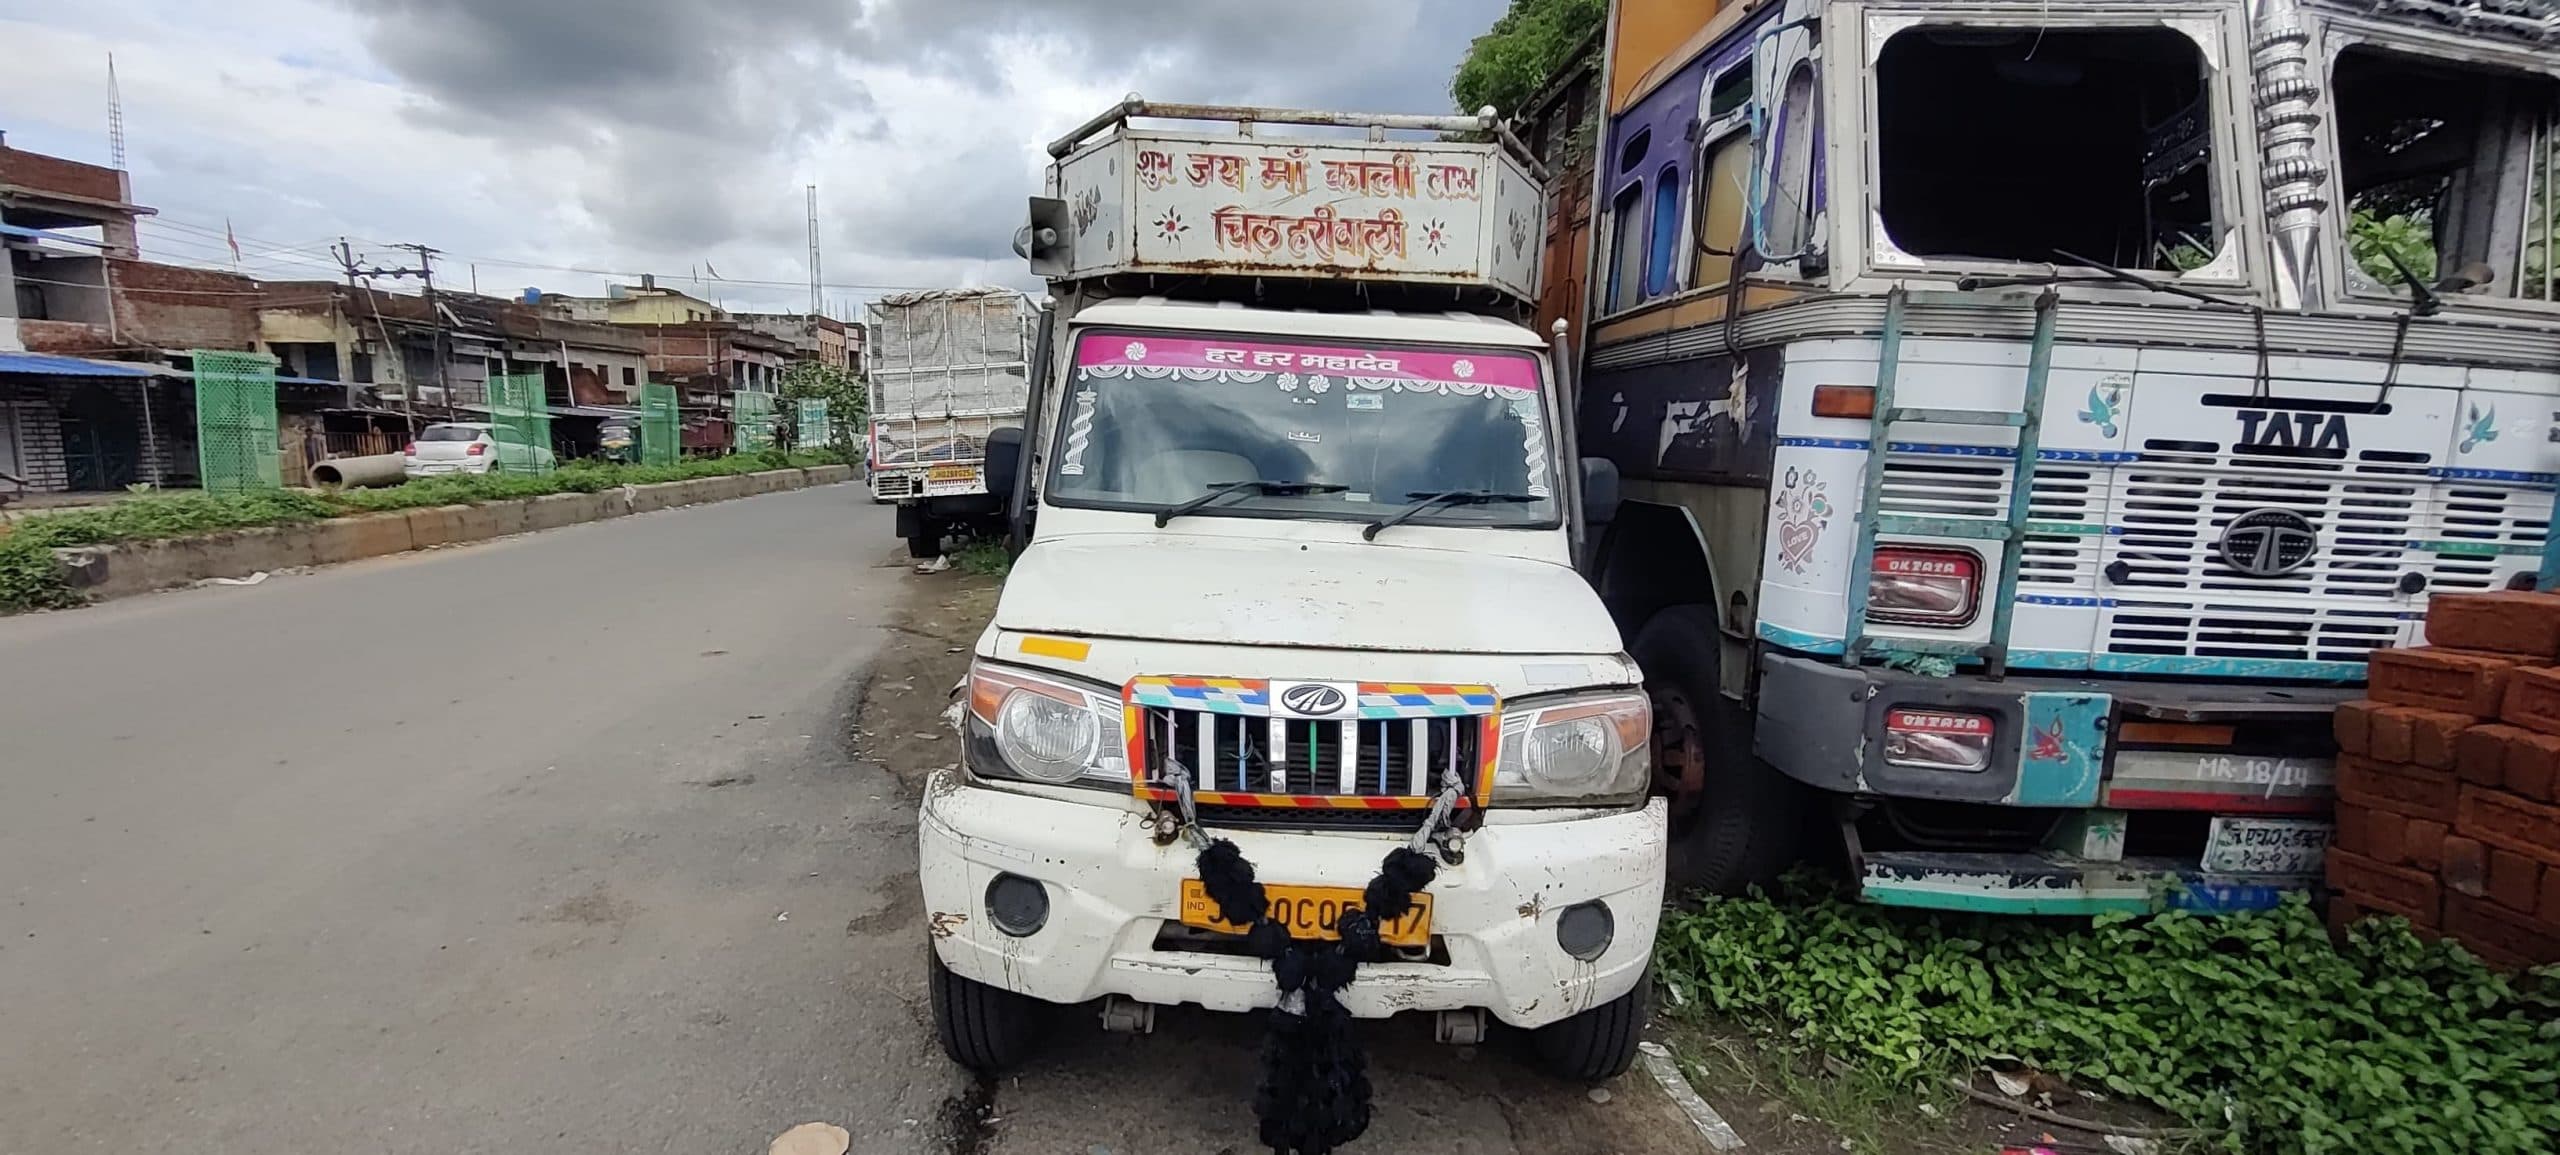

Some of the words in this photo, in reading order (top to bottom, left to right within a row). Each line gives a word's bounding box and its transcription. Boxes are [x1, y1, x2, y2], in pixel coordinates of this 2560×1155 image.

[1137, 151, 1177, 191] शुभ
[1185, 153, 1249, 192] जय
[1259, 148, 1309, 194] माँ
[1321, 152, 1419, 199] काली
[1205, 349, 1247, 363] हर
[1252, 351, 1295, 366] हर
[1300, 353, 1400, 372] महादेव
[2236, 410, 2350, 449] TATA
[1787, 531, 1809, 548] LOVE
[1889, 560, 1910, 571] OK
[1912, 560, 1956, 573] TATA
[1903, 715, 1923, 727] OK
[1925, 716, 1980, 729] TATA
[1186, 901, 1206, 911] IND
